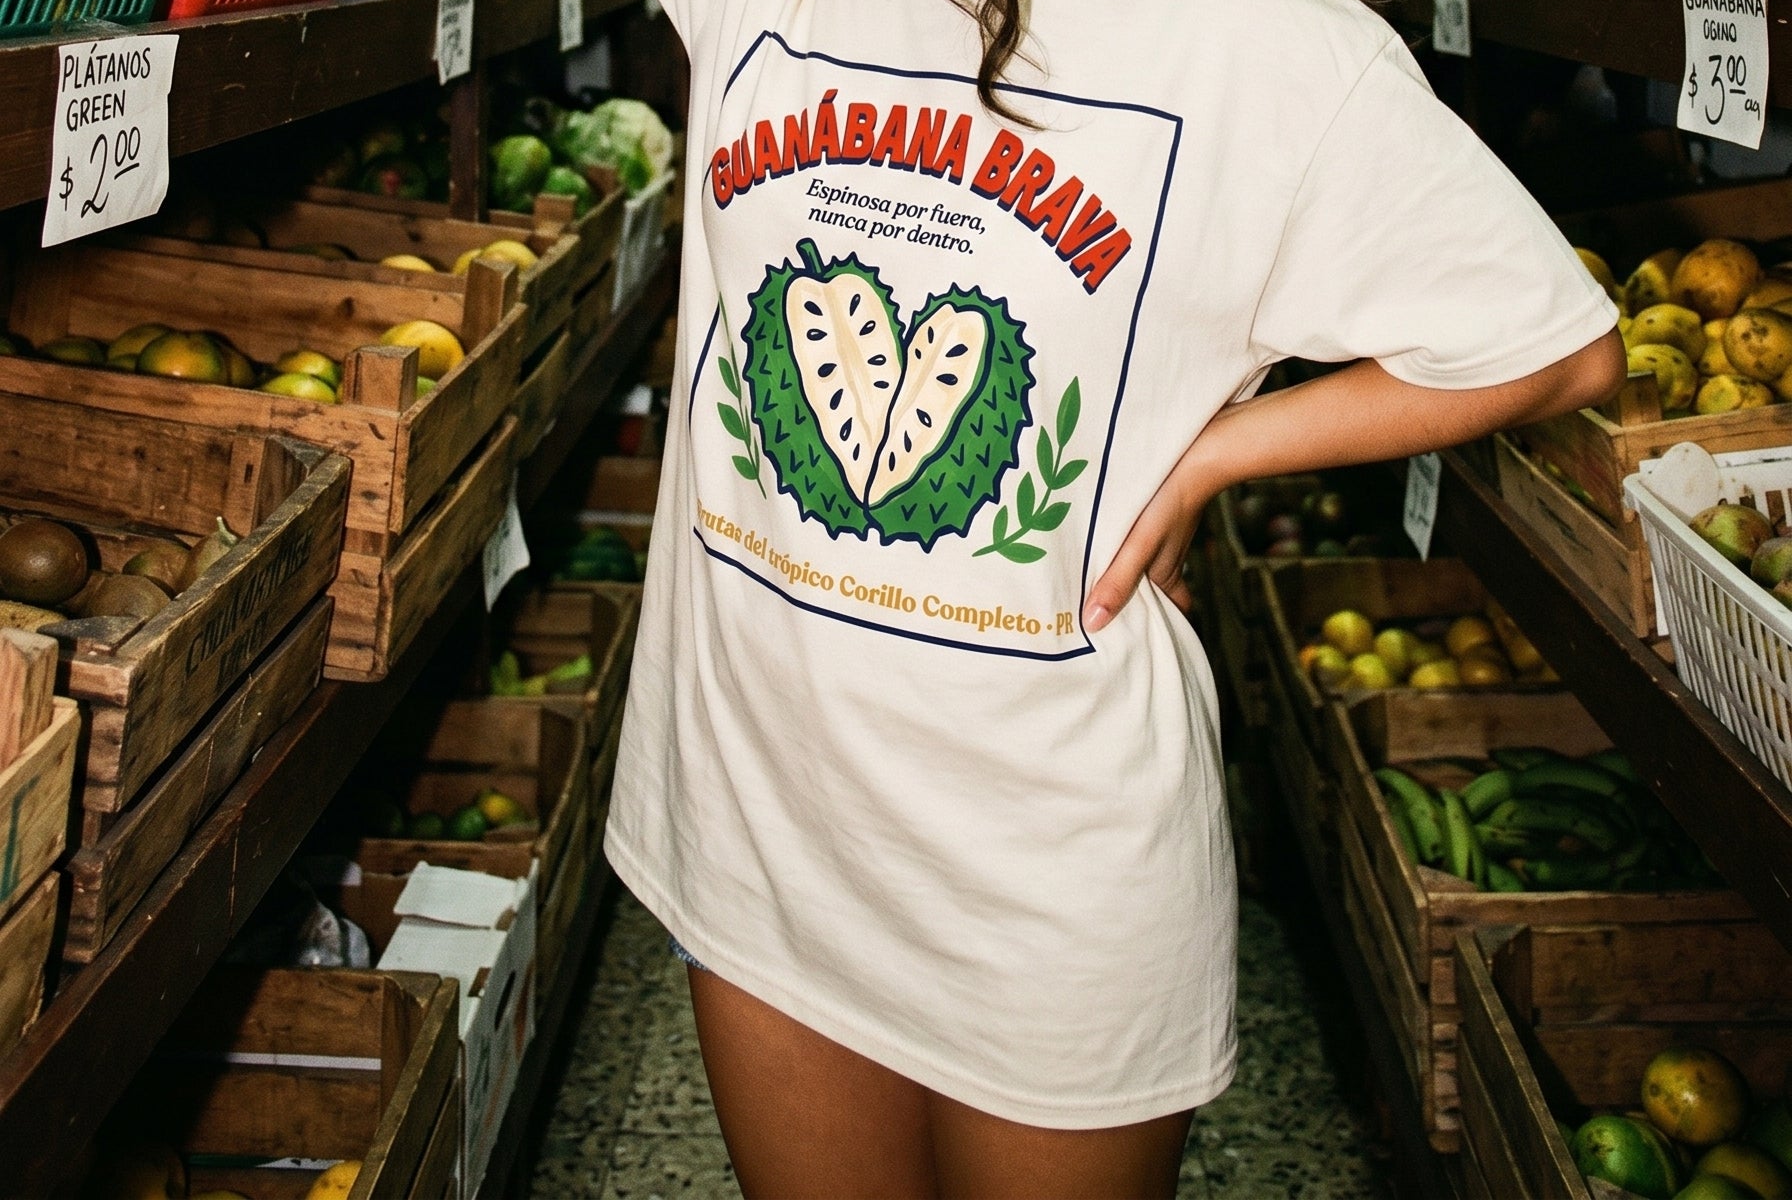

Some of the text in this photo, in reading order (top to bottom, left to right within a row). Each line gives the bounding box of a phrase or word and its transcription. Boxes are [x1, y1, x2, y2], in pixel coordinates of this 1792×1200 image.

[62, 43, 150, 92] PLÁTANOS
[66, 89, 126, 132] GREEN
[711, 88, 1133, 296] GUANÁBANA BRAVA
[806, 178, 986, 235] Espinosa por fuera,
[808, 207, 974, 254] nunca por dentro.
[743, 530, 768, 559] del
[768, 547, 834, 591] trópico
[839, 575, 917, 613] Corillo
[922, 595, 1041, 635] Completo
[1055, 611, 1074, 636] PR
